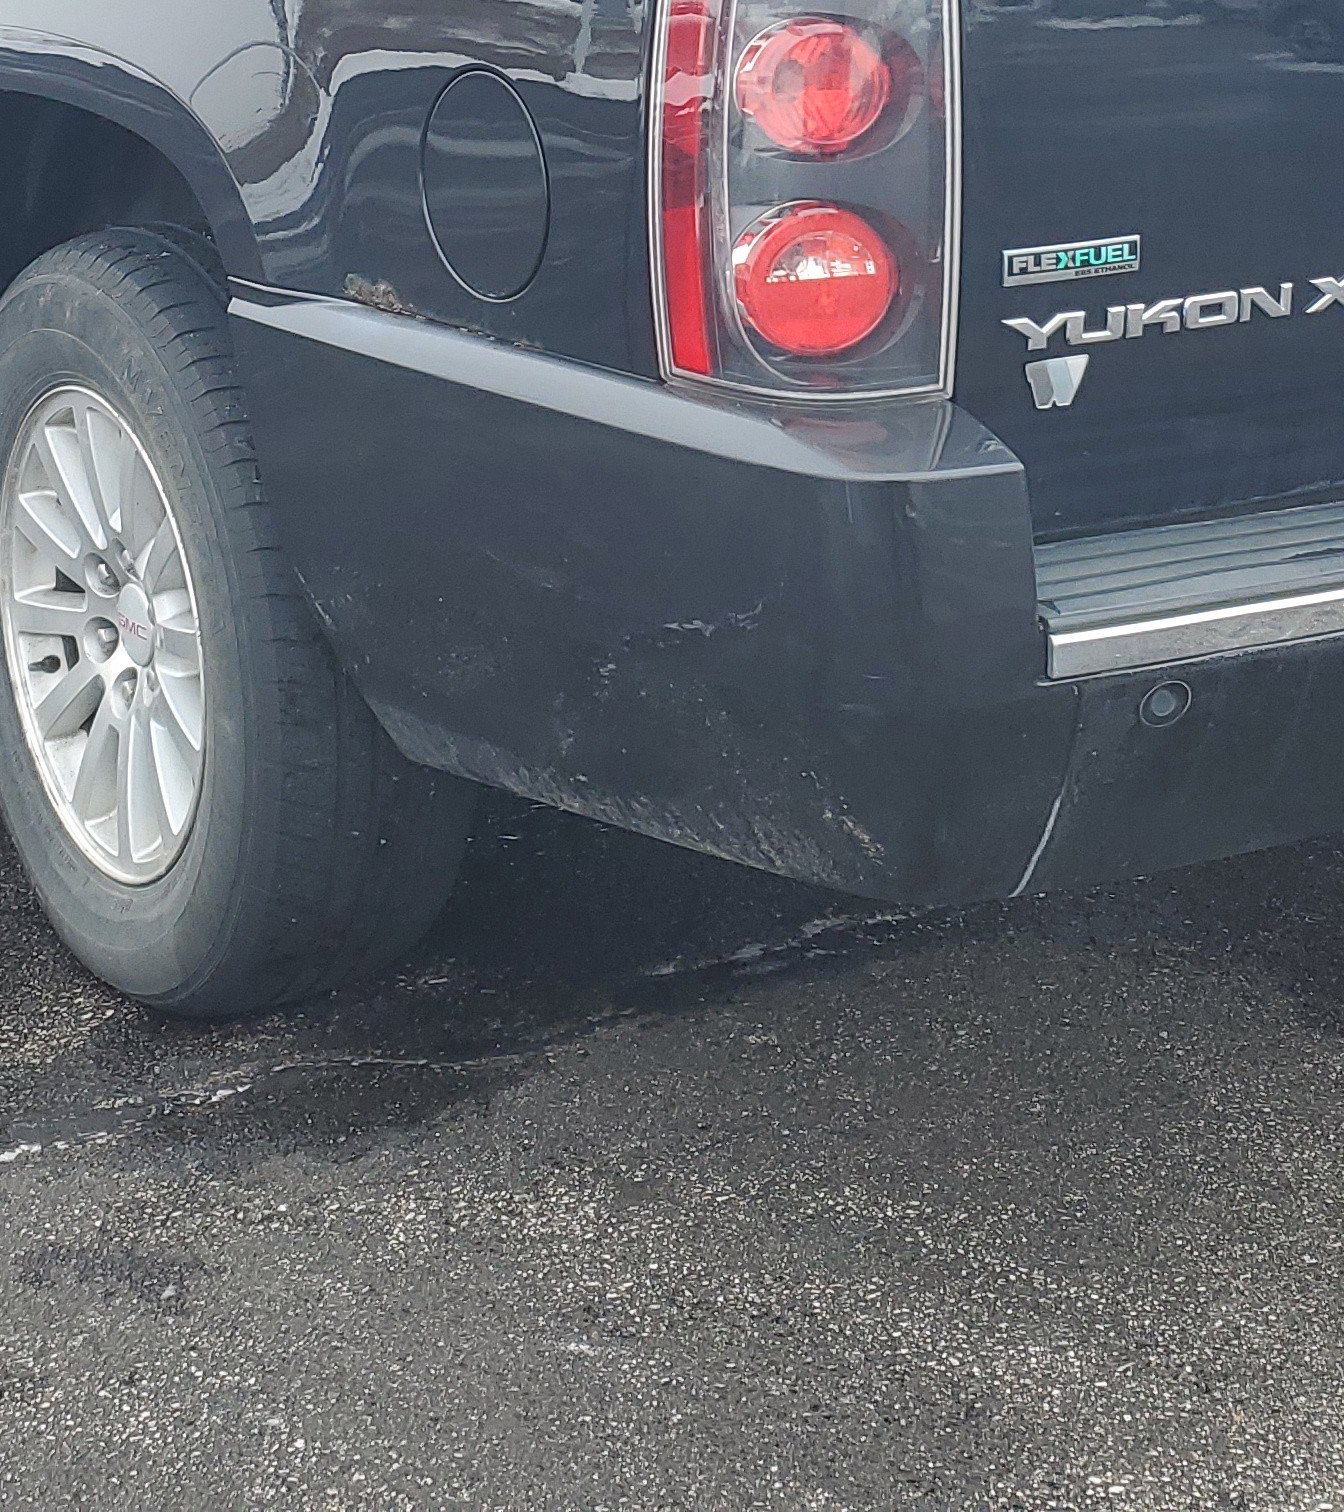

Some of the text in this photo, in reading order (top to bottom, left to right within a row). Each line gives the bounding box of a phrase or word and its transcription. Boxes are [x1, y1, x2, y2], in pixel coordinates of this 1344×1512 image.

[1012, 243, 1137, 274] FLEXFUEL
[1001, 282, 1294, 351] YUKON
[117, 611, 148, 641] GMC
